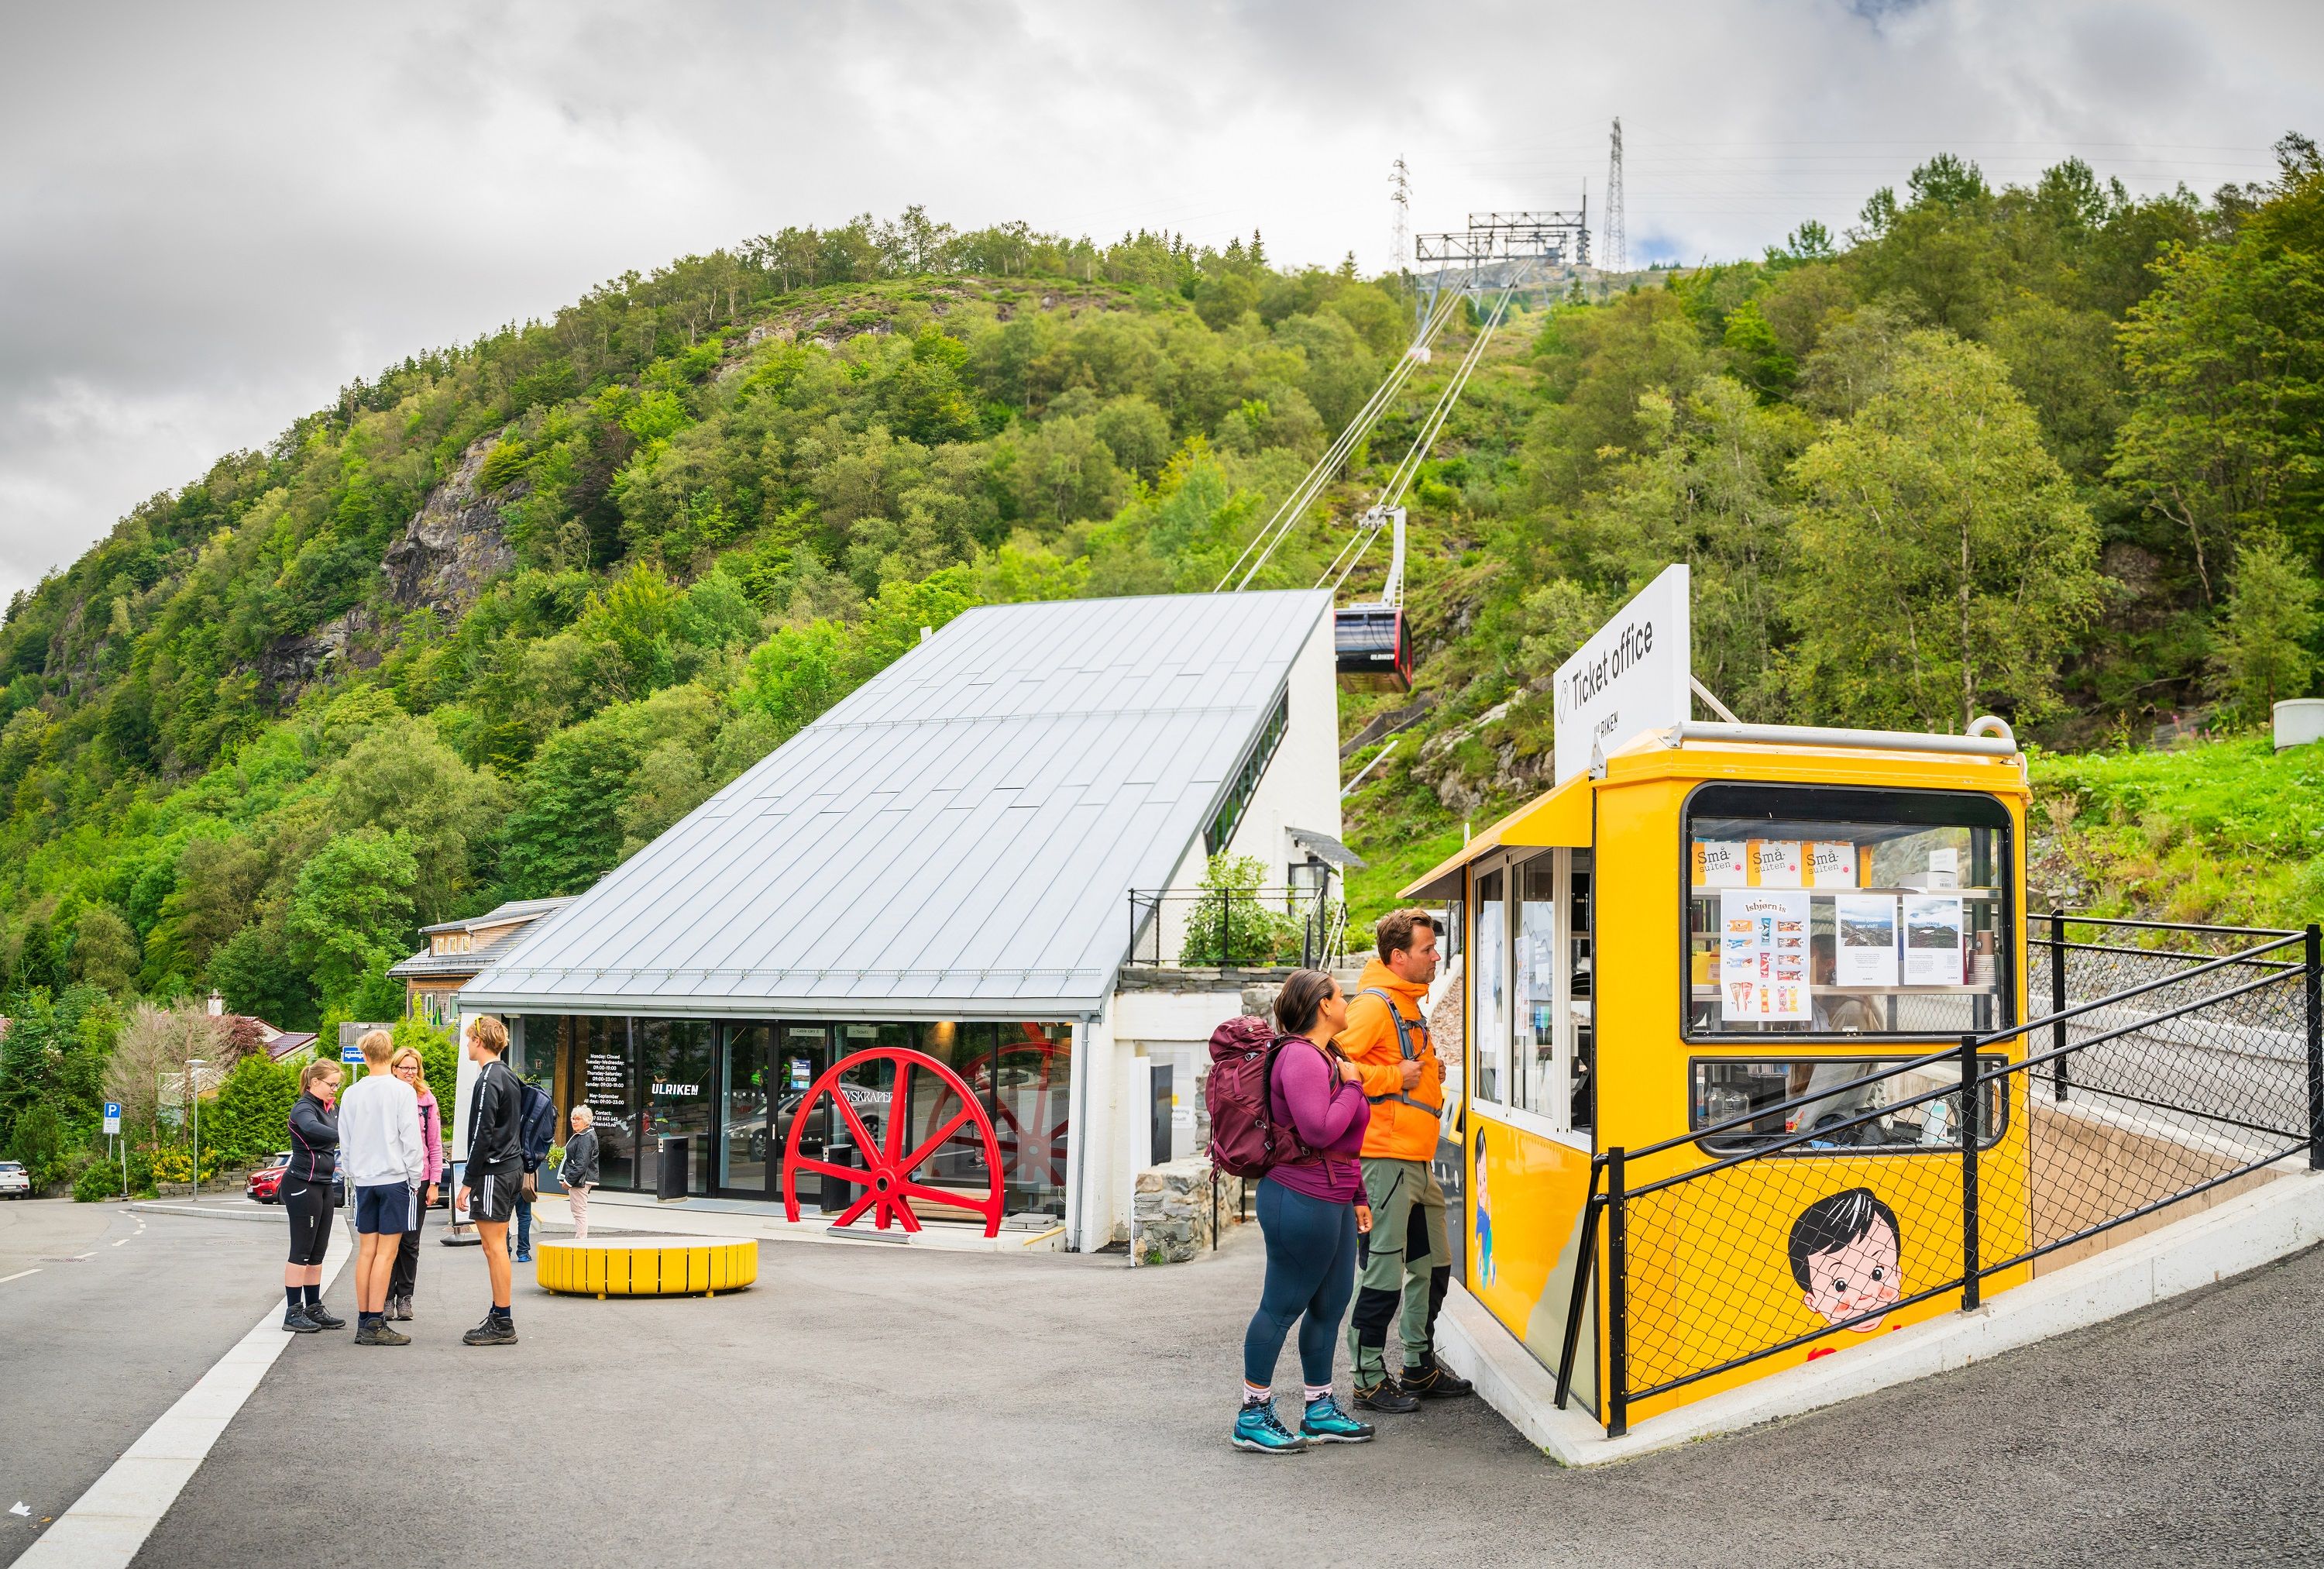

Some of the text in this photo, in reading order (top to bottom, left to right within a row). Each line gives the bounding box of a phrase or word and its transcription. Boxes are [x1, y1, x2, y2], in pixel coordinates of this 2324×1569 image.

[1573, 621, 1652, 711] Ticket office
[1699, 862, 1731, 872] sulten
[1755, 862, 1786, 873] sulten
[1808, 863, 1839, 874] sulten
[1745, 900, 1786, 913] Isbjørn is
[651, 1083, 699, 1095] ULRIKEN
[108, 1104, 117, 1117] P
